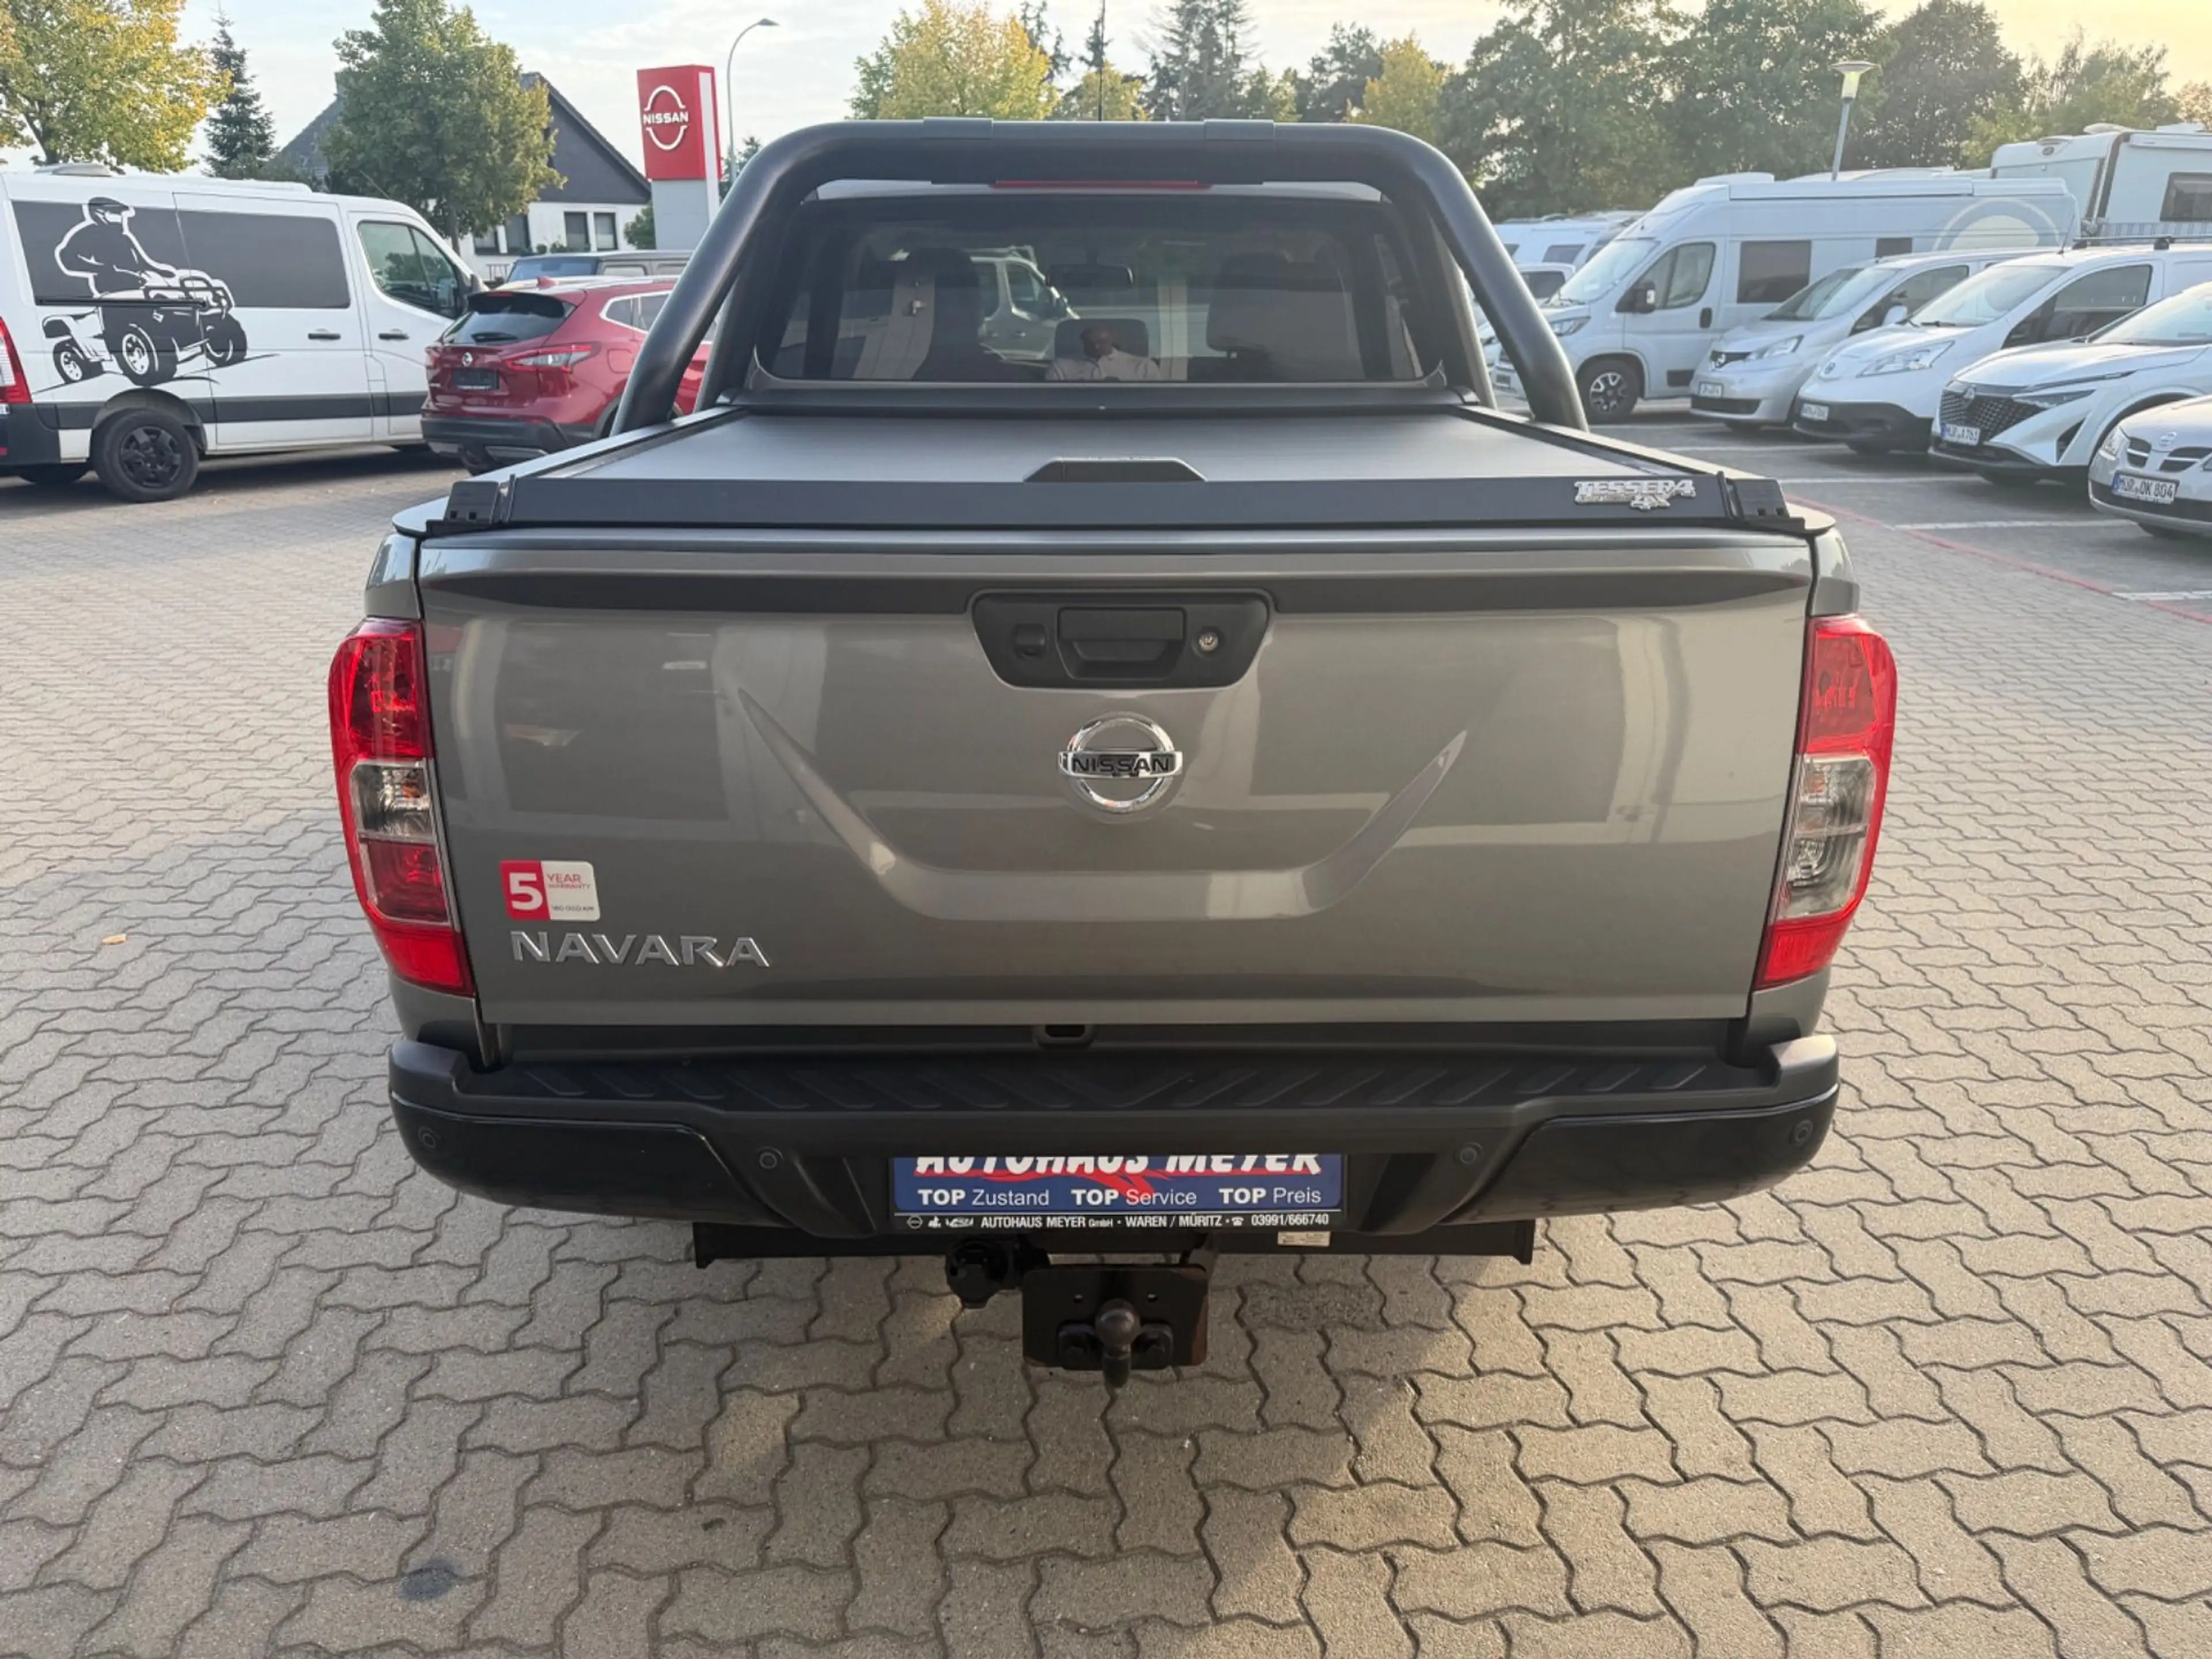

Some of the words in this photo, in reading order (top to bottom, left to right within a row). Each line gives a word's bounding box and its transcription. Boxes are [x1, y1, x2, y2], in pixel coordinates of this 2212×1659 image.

[643, 111, 688, 124] NISSAN
[1073, 758, 1169, 773] NISSAN
[547, 873, 581, 883] YEAR
[509, 872, 543, 910] 5
[511, 931, 770, 967] NAVARA
[918, 1189, 966, 1206] TOP
[972, 1189, 1049, 1206] Zustand
[1071, 1189, 1119, 1206] TOP
[1126, 1188, 1197, 1206] Service
[1219, 1188, 1266, 1204] TOP
[1274, 1187, 1321, 1203] Preis
[980, 1216, 1042, 1228] AUTOHAUS
[1046, 1216, 1086, 1228] MEYER
[1125, 1215, 1166, 1228] WAREN
[1179, 1213, 1222, 1227] MÜRITZ
[1251, 1214, 1329, 1226] 03991/666740
